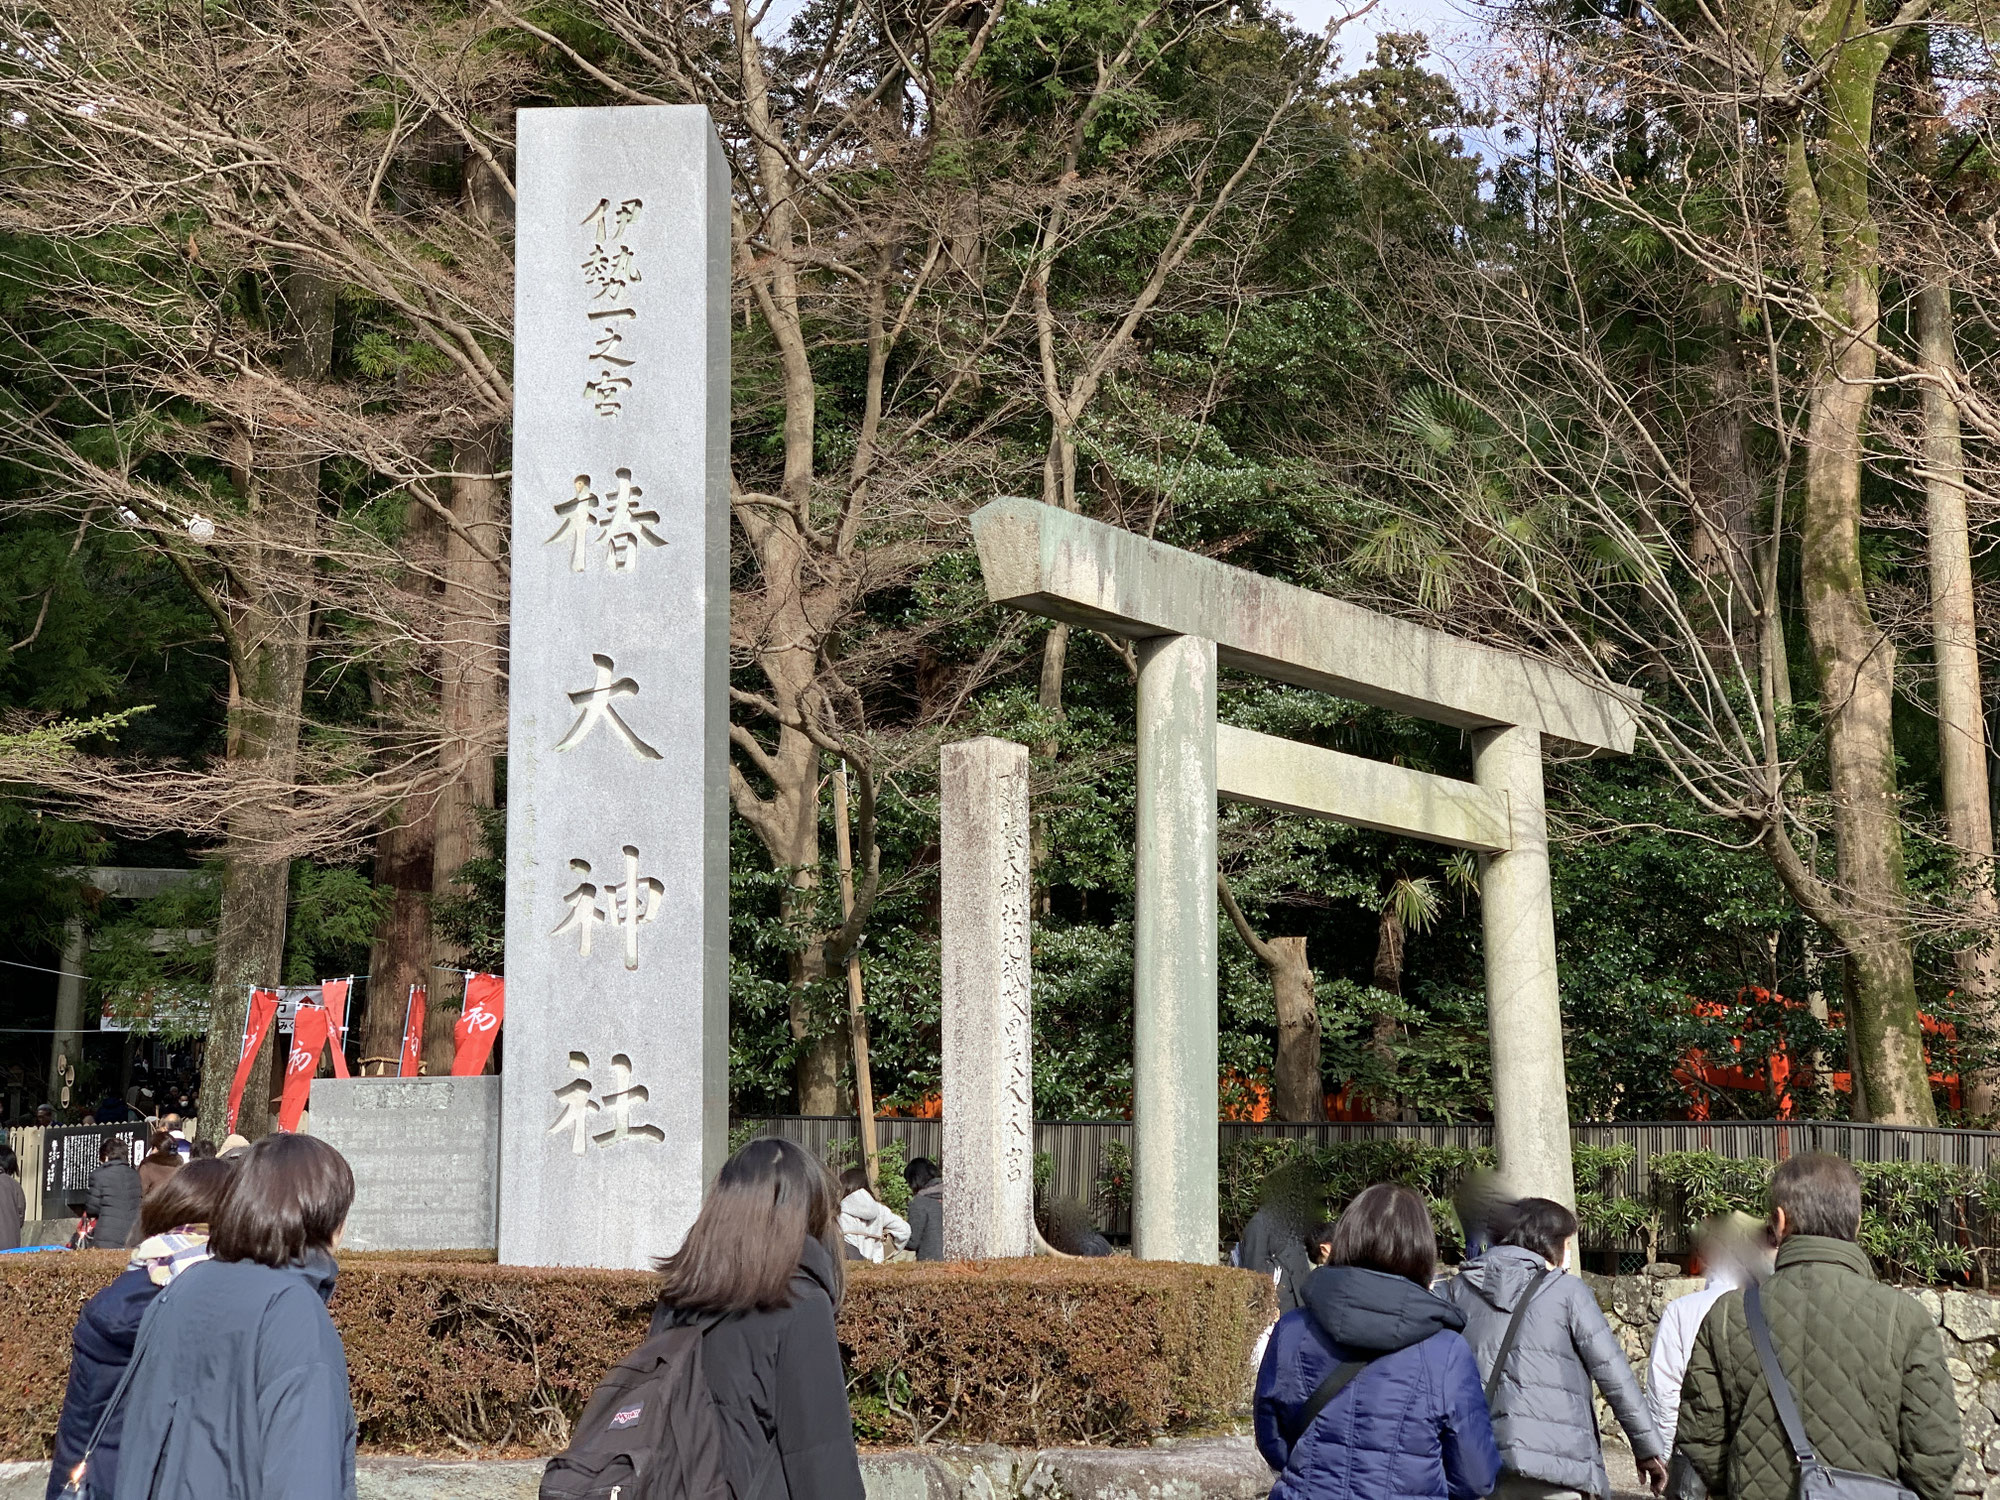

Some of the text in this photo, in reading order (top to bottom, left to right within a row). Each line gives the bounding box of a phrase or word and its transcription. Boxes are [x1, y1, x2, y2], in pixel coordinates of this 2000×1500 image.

[543, 197, 670, 1157] 伊勢一之宮 椿大神社
[462, 1001, 497, 1034] 初
[289, 1040, 313, 1075] 初
